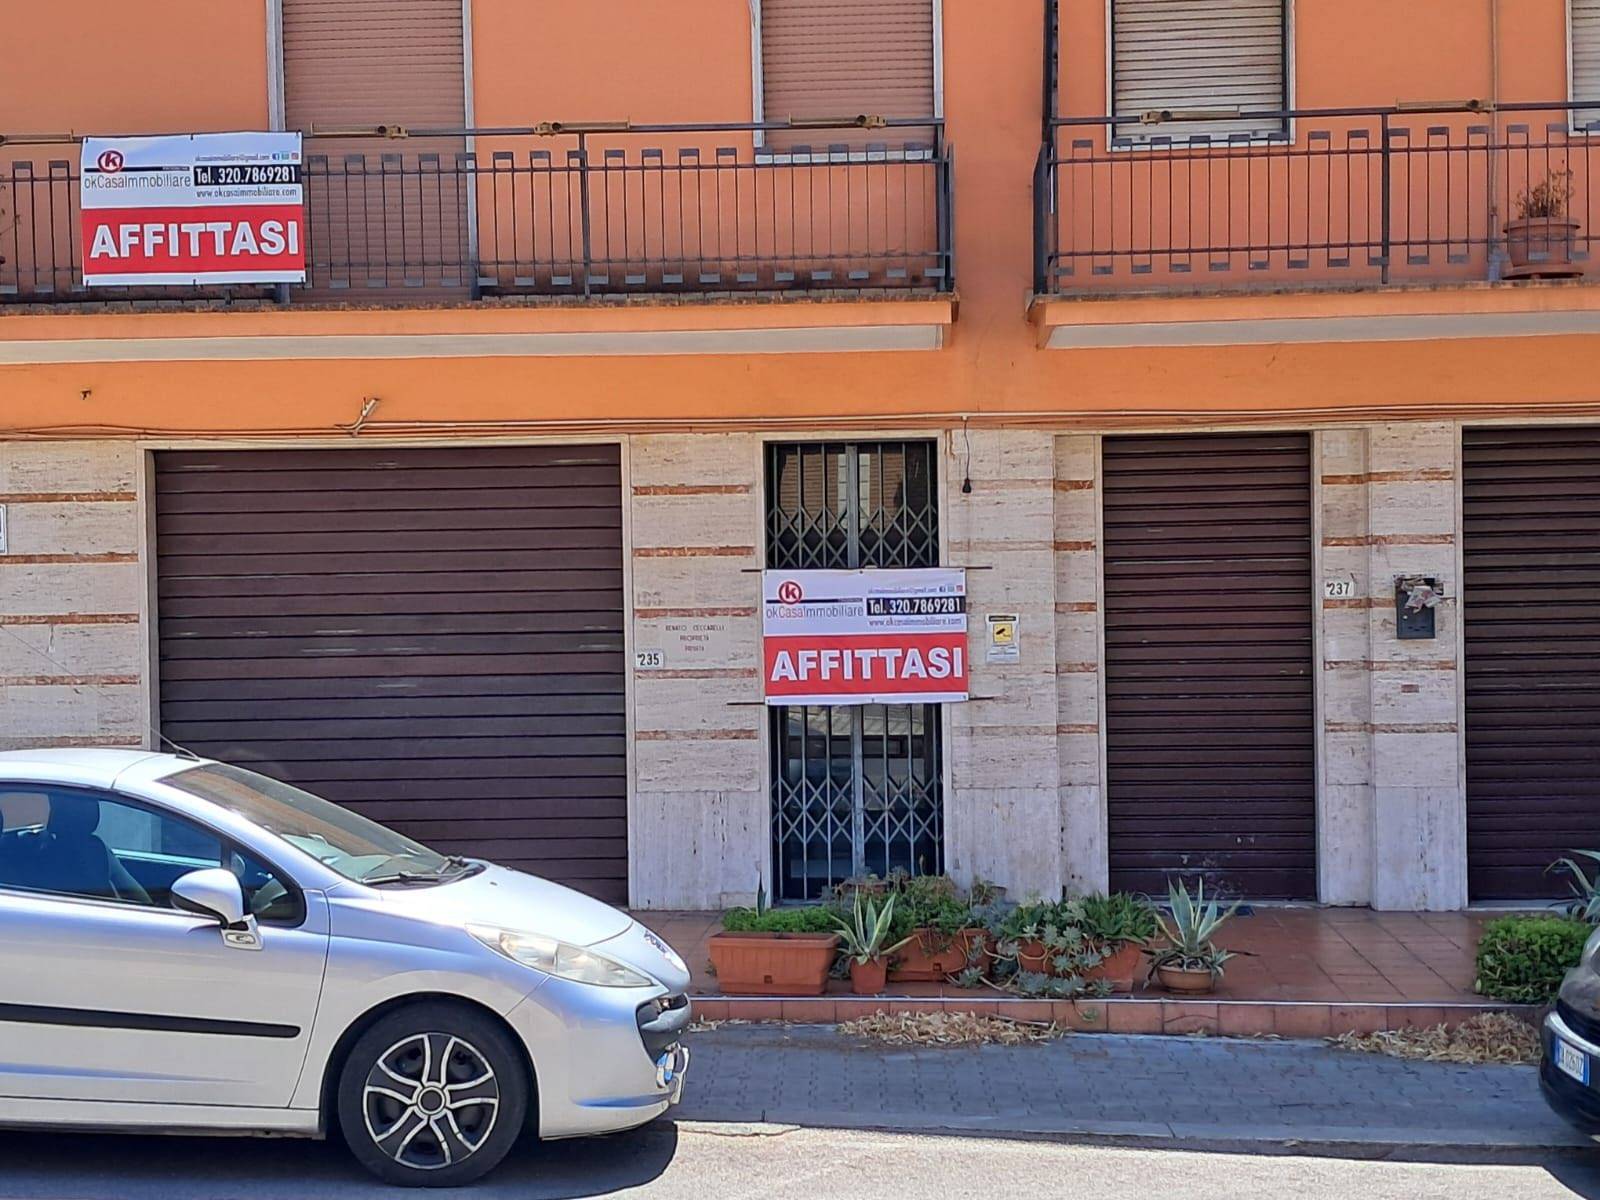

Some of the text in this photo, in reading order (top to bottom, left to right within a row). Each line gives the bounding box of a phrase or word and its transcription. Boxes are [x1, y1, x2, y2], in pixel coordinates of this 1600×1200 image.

[84, 173, 191, 189] okCasaImmobiliare
[195, 165, 296, 184] Tel. 320.7869281
[89, 220, 299, 259] AFFITTASI
[1326, 582, 1350, 595] 237
[766, 604, 864, 619] okCasaImmobiliare
[868, 598, 961, 614] Tel. 320.7869281
[637, 653, 660, 666] 235
[770, 647, 964, 682] AFFITTASI
